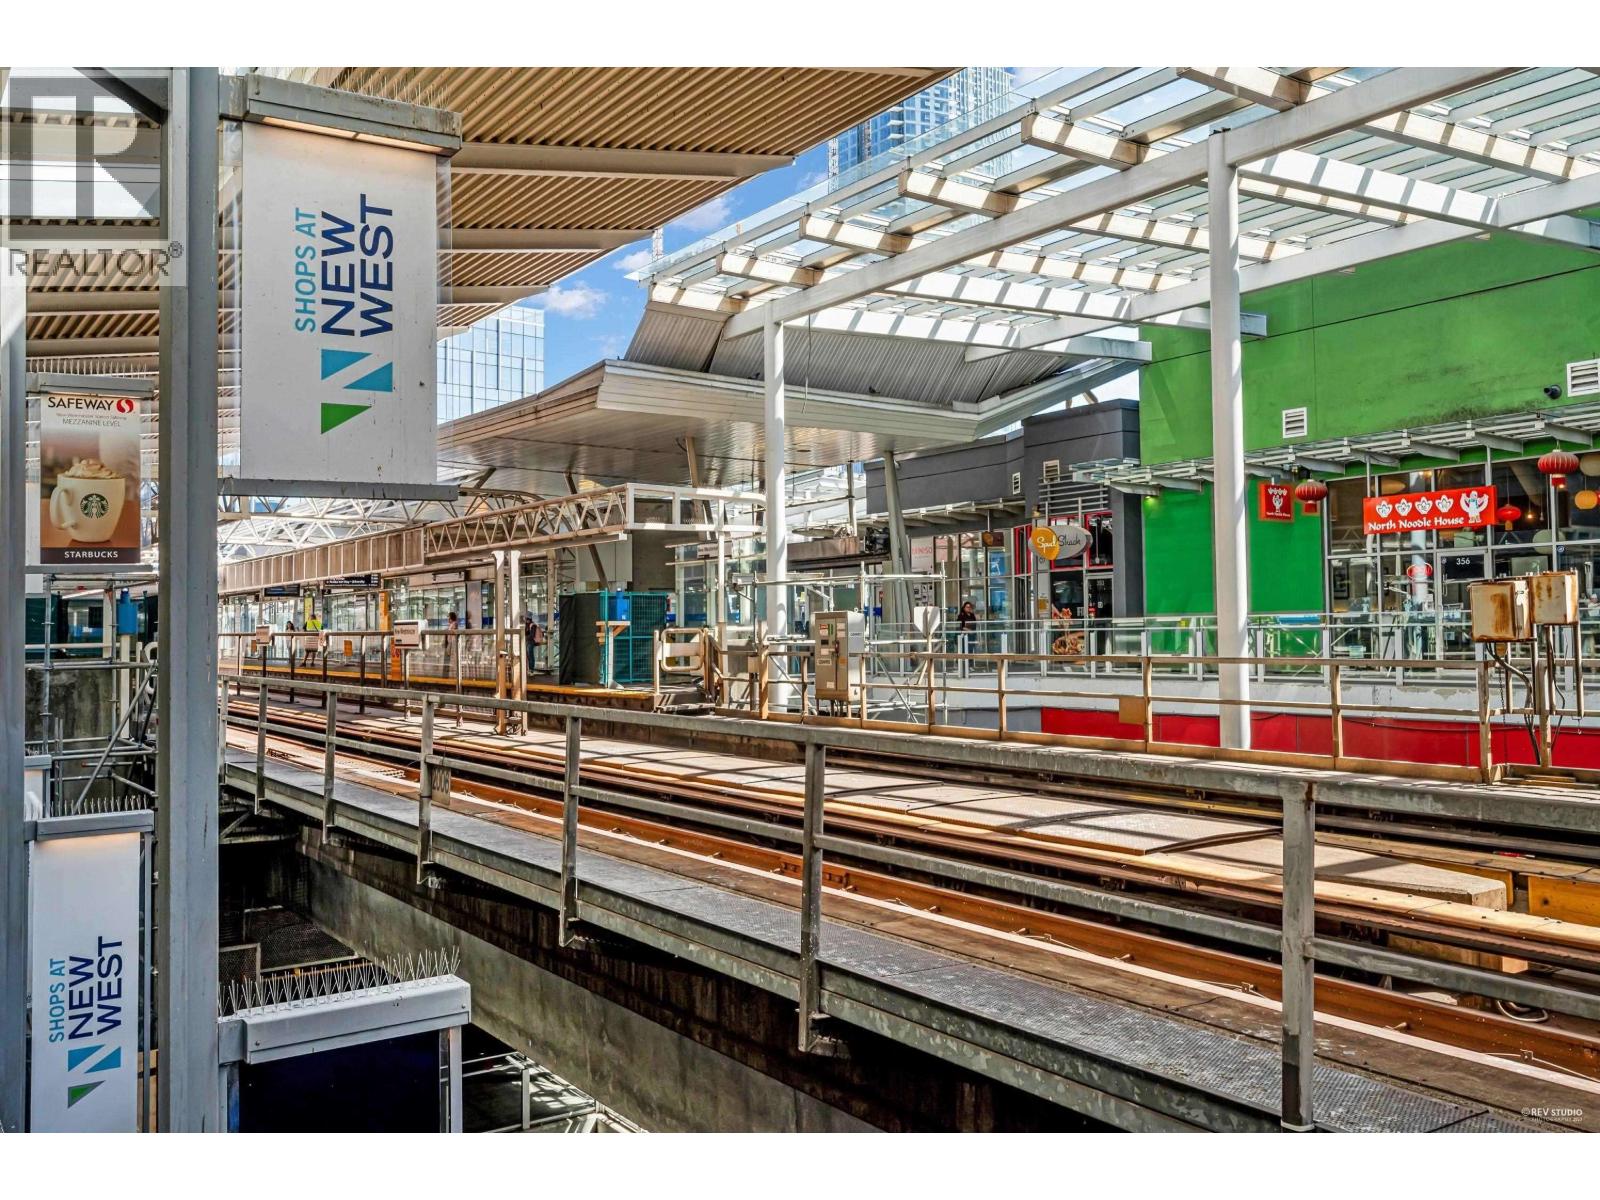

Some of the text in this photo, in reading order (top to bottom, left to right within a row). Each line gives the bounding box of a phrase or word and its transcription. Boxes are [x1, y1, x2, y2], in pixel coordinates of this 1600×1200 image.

[295, 207, 316, 333] SHOPS AT
[321, 210, 355, 336] NEW
[359, 193, 394, 338] WEST
[47, 396, 114, 411] SAFEWAY
[62, 418, 121, 428] MEZZANINE LEVEL
[1057, 533, 1081, 547] Shack
[1368, 516, 1465, 531] North Noodle House
[64, 550, 119, 559] STARBUCKS
[1455, 557, 1471, 566] 356
[49, 958, 65, 1043] SHOPS AT
[68, 955, 94, 1040] NEW
[97, 935, 122, 1036] WEST
